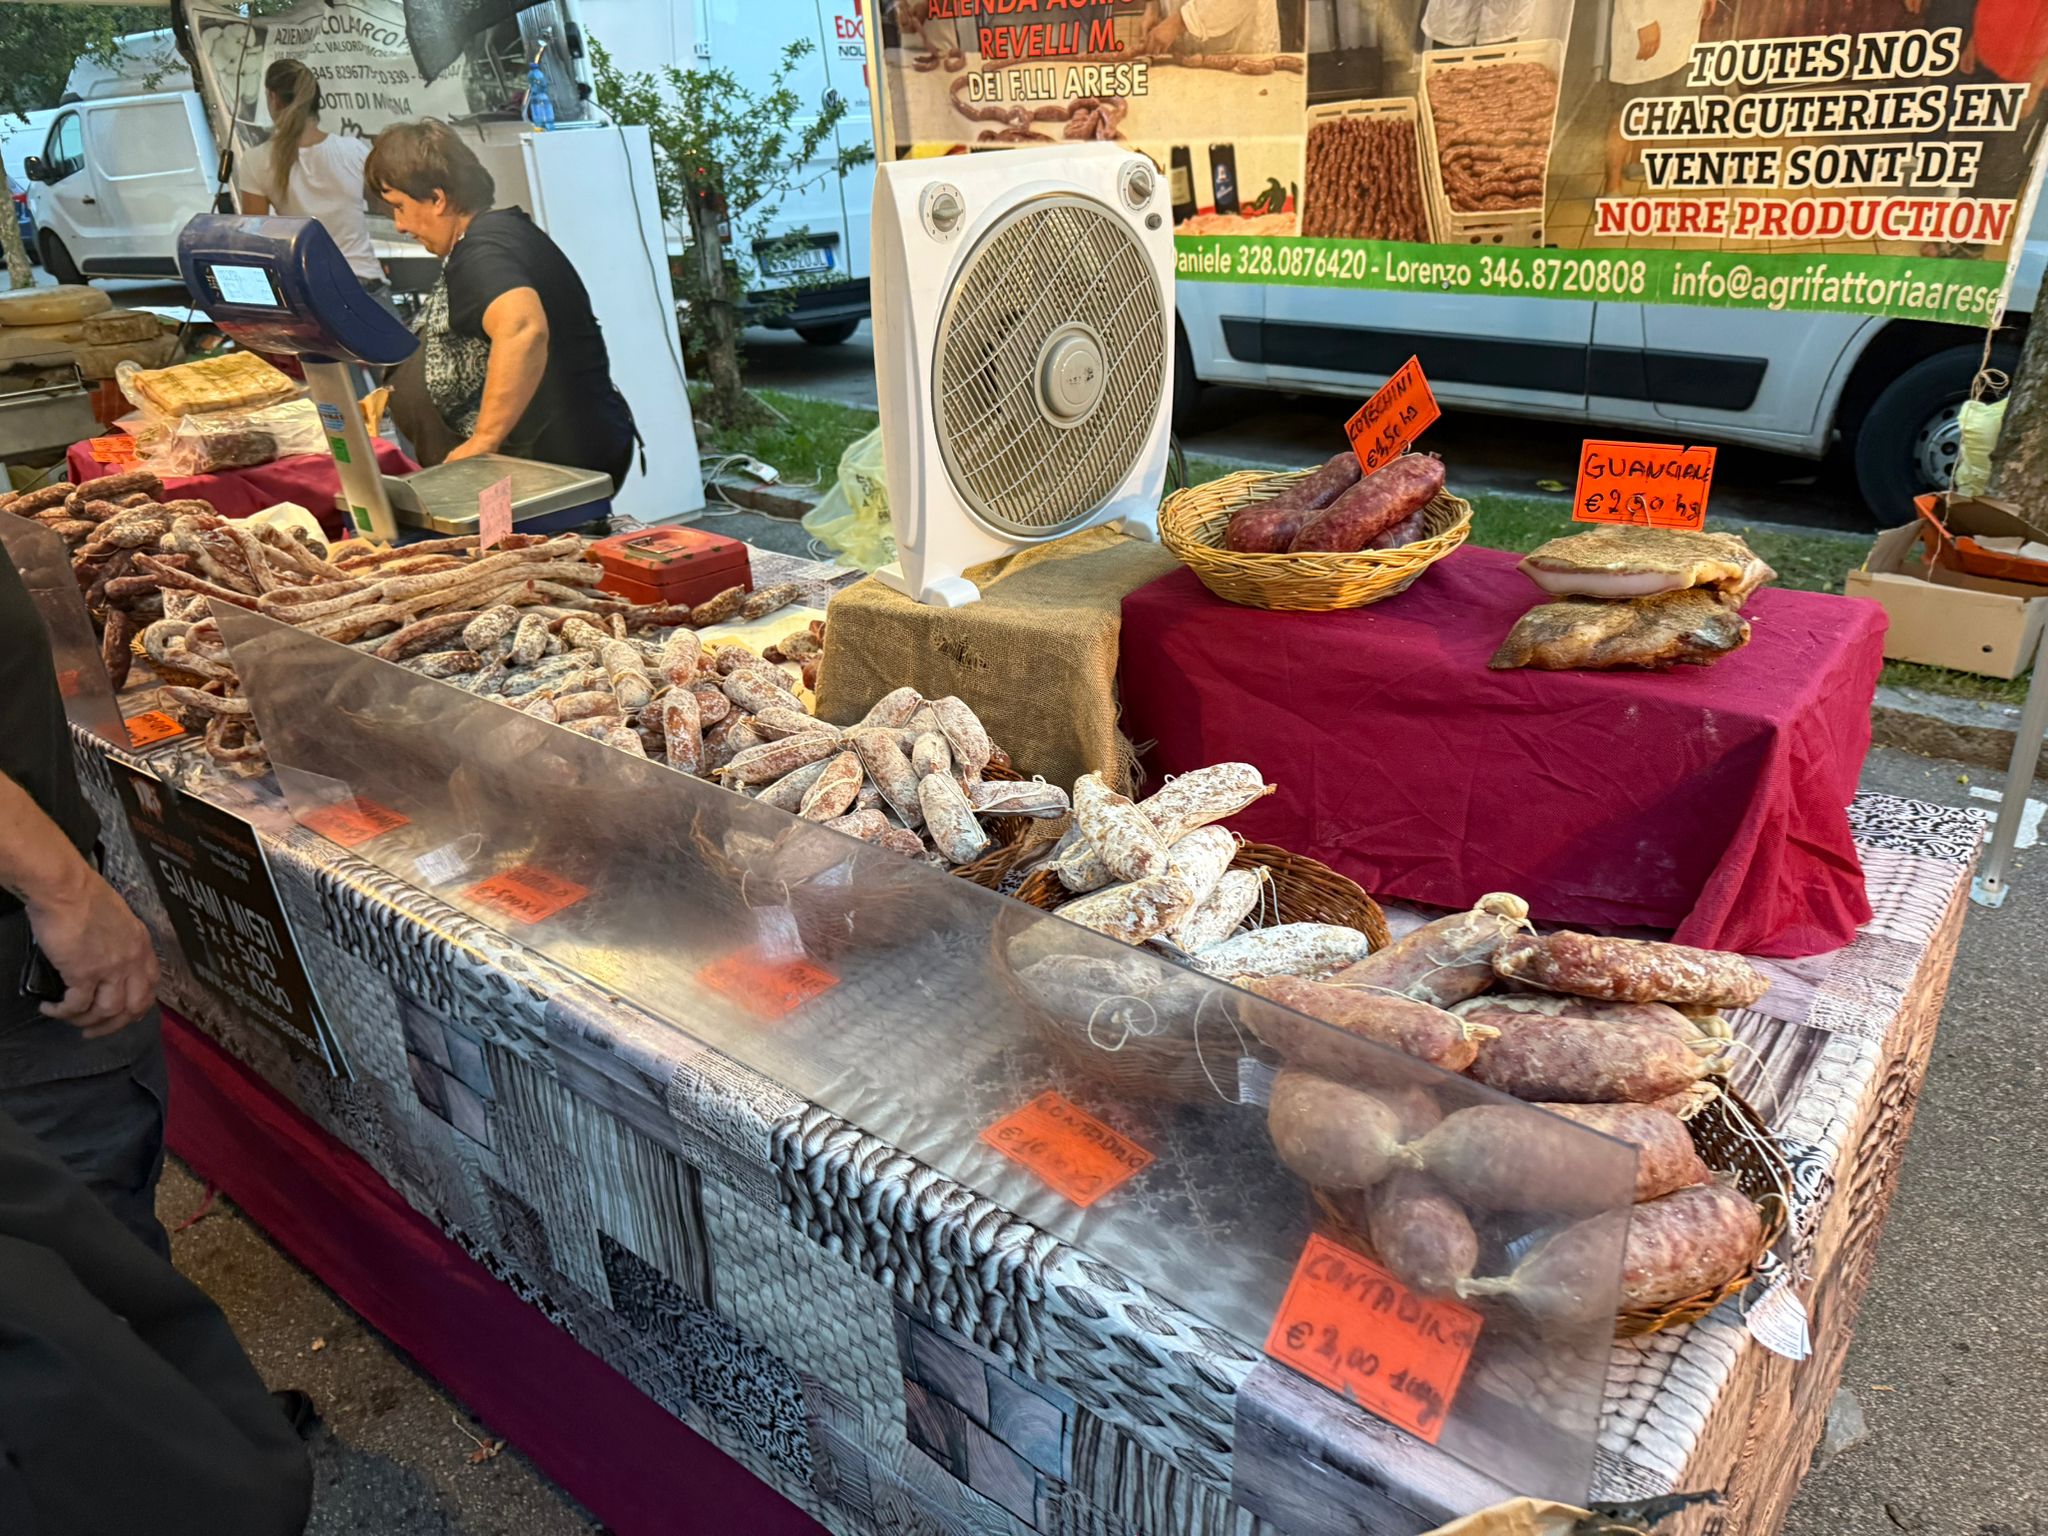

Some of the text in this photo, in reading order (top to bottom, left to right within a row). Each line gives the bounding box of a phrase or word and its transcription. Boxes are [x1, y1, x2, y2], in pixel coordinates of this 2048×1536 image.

[978, 17, 1125, 60] REVELLI M.
[1691, 30, 1959, 84] TOUTES NOS
[967, 63, 1149, 102] DEI F.LLI ARESE
[1622, 86, 2027, 138] CHARCUTERIES EN
[1643, 144, 1981, 187] VENTE SONT DE
[1596, 200, 2014, 242] NOTRE PRODUCTION
[1173, 244, 1232, 274] aniele
[1236, 245, 1367, 280] 328.0876420
[1384, 251, 1472, 287] Lorenzo
[1479, 256, 1647, 295] 346.8720808
[158, 859, 228, 926] SALAMI
[223, 894, 284, 960] MISTI
